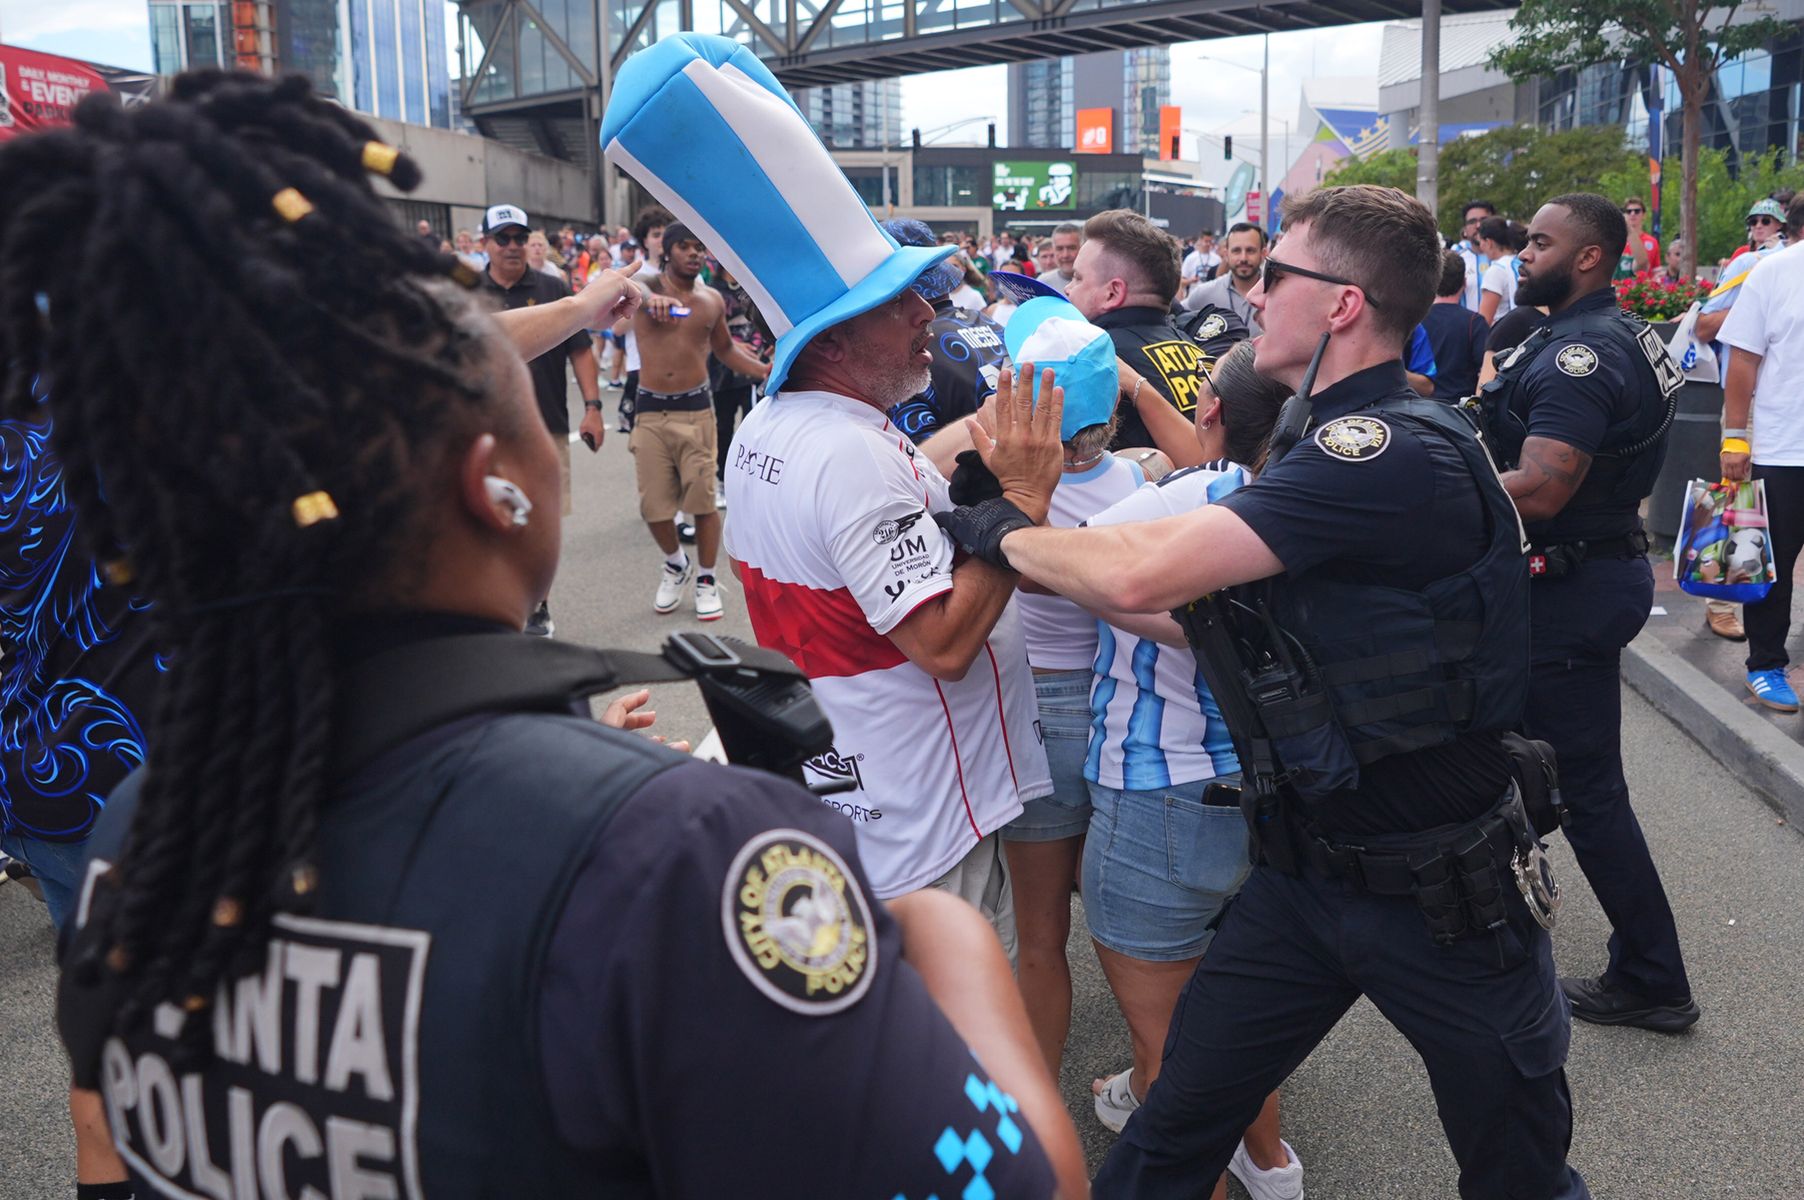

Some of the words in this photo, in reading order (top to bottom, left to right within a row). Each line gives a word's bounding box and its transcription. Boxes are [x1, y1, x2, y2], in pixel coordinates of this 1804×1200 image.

[1321, 436, 1361, 457] POLICE
[890, 534, 927, 562] UM
[102, 1036, 399, 1200] POLICE
